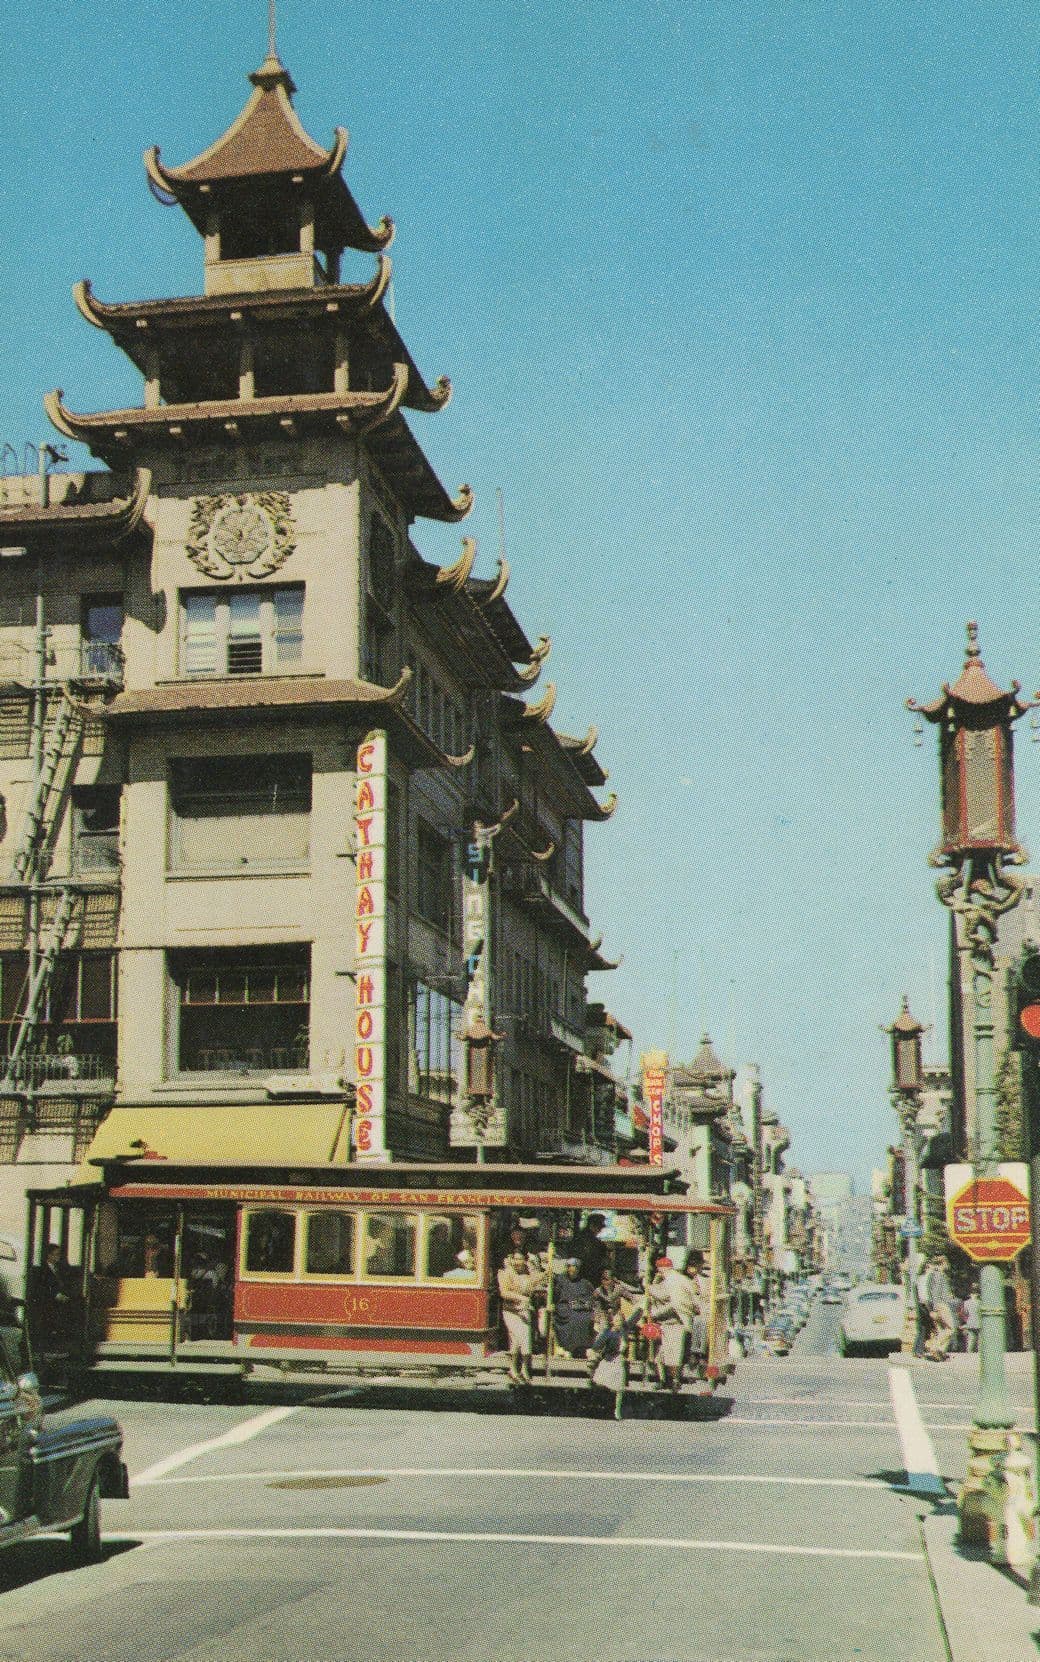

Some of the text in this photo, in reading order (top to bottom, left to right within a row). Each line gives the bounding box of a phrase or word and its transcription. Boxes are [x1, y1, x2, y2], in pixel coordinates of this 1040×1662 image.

[356, 745, 375, 1151] CATHAY HOUSE
[206, 1189, 524, 1205] MUNICIPAL RAILWAY OF SAN FRANCISCO
[957, 1206, 1026, 1232] STOP
[352, 1297, 369, 1312] 16
